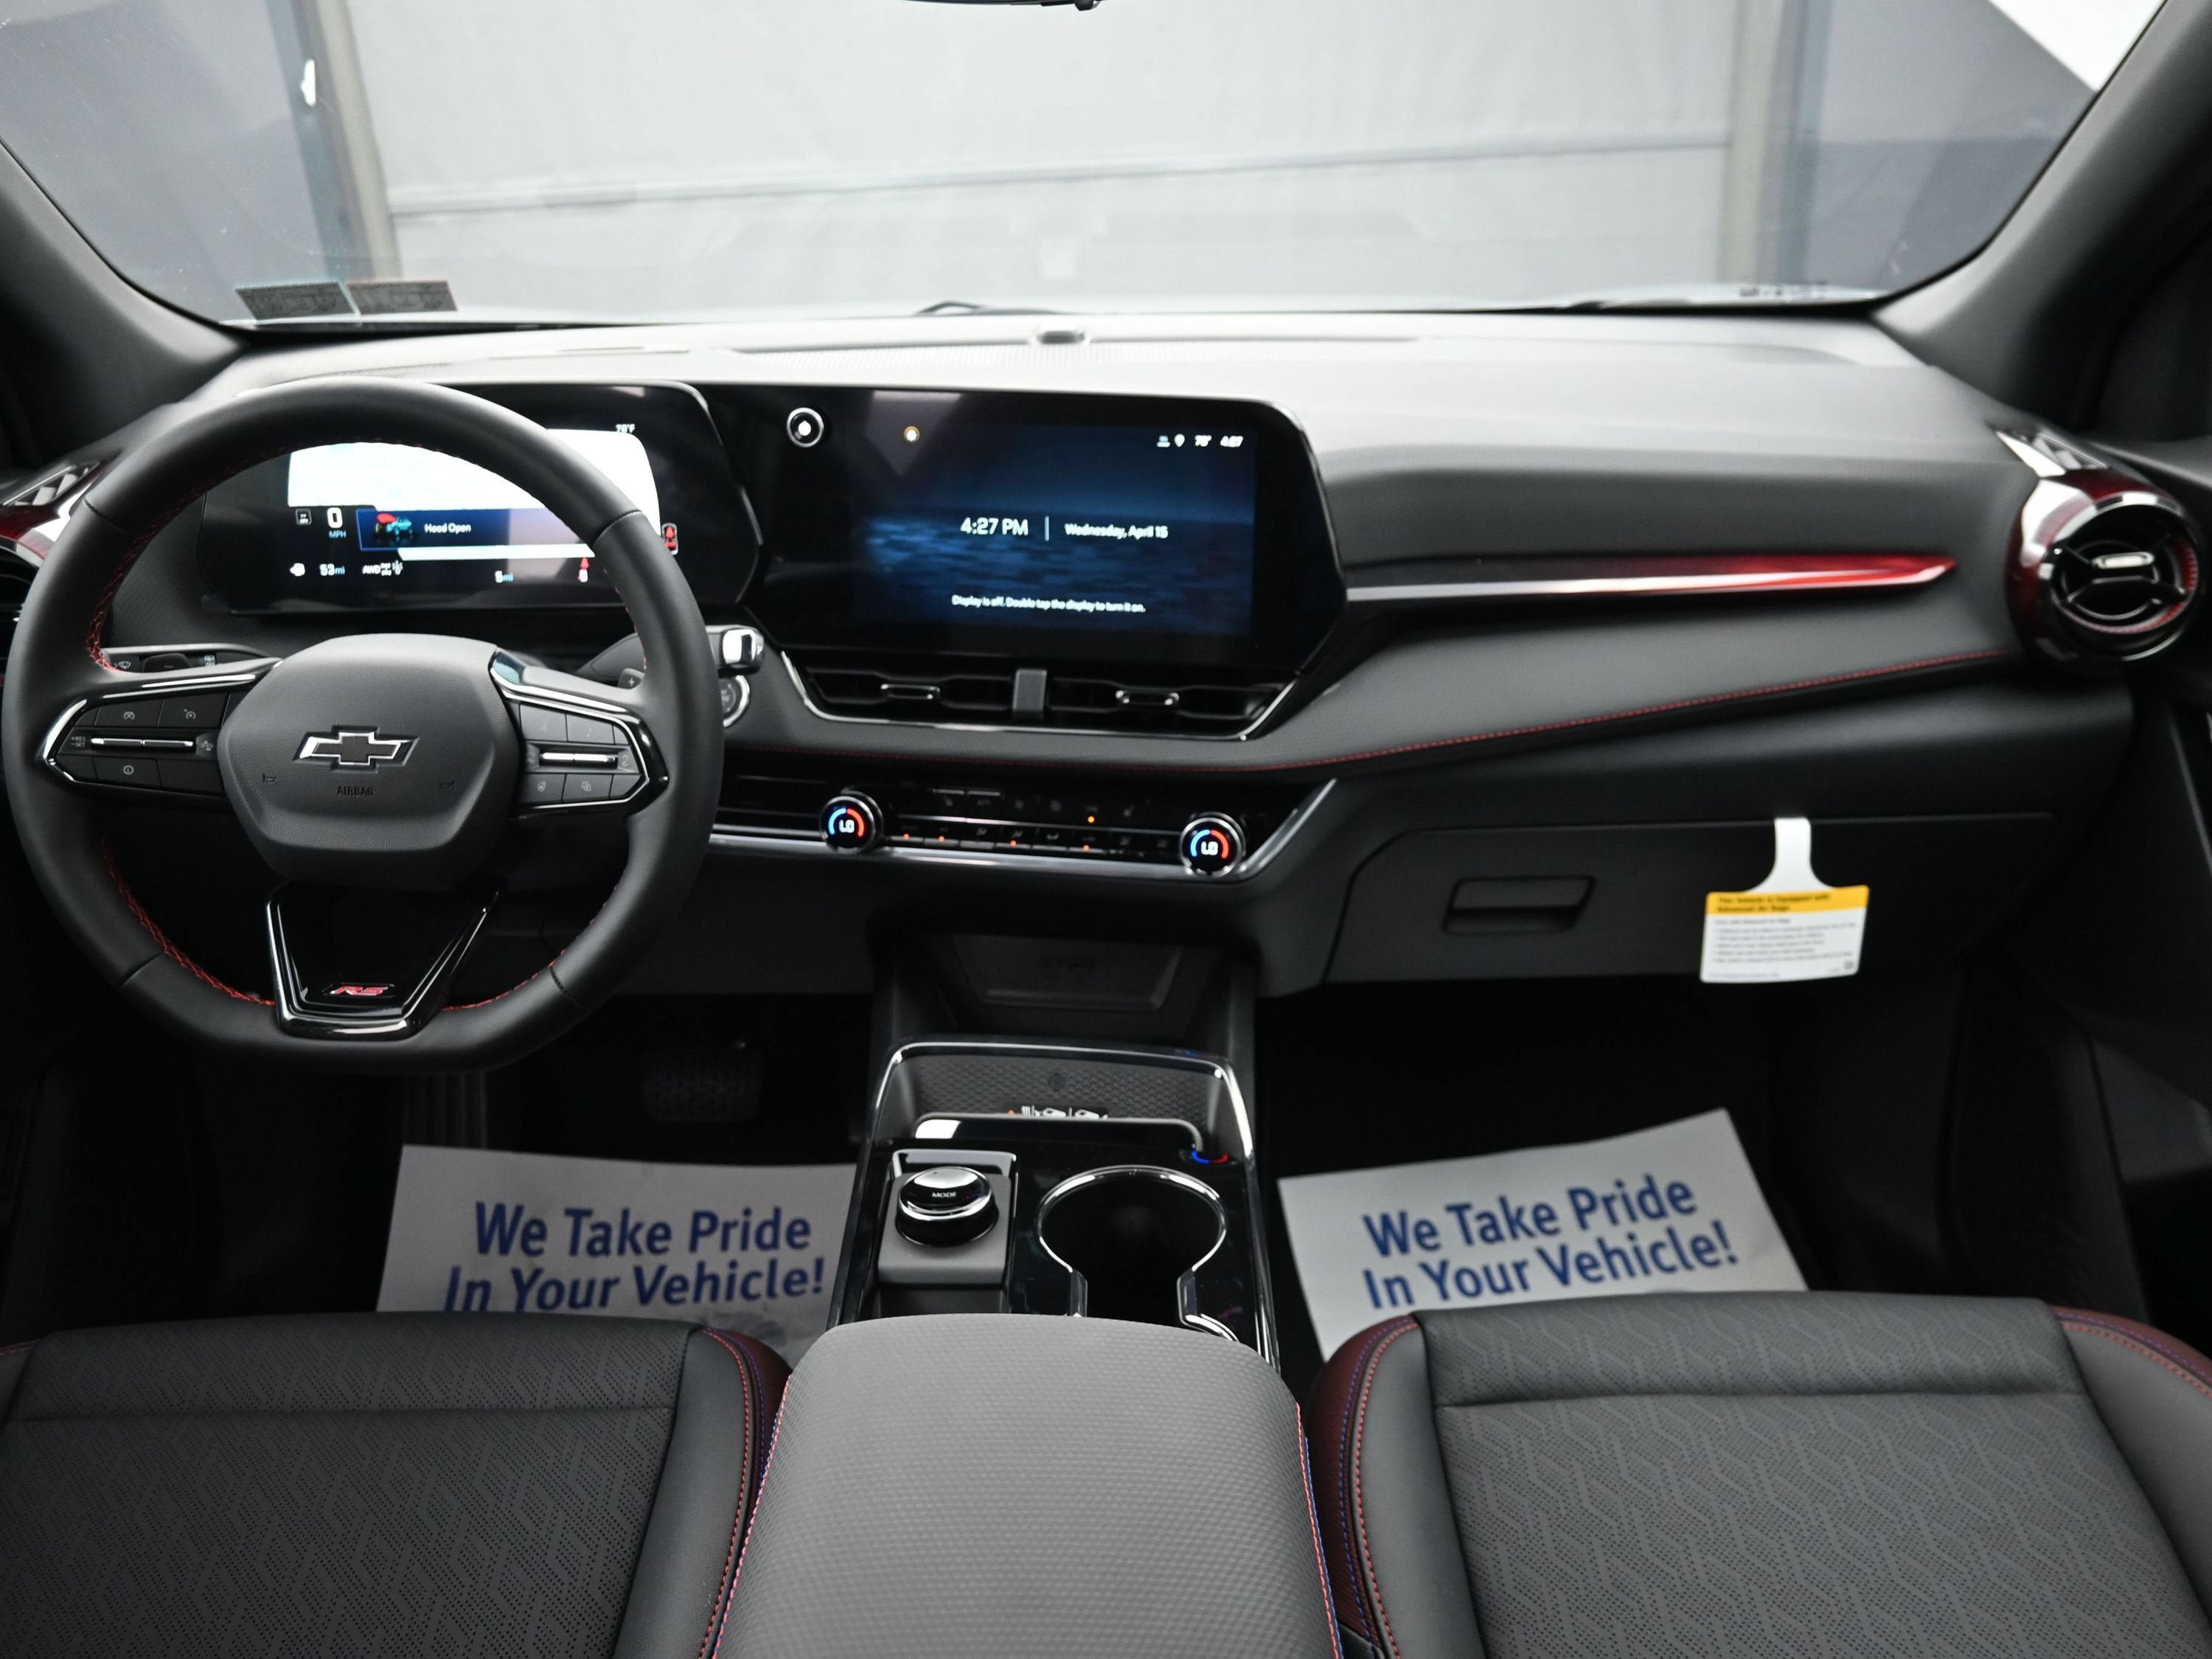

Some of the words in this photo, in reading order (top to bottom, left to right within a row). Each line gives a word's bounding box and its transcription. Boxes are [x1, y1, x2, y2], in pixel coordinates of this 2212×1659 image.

[326, 507, 344, 529] 0
[960, 517, 999, 535] 4:27
[1001, 518, 1029, 536] PM
[329, 530, 347, 539] MPH
[424, 522, 447, 534] Hood
[448, 523, 472, 535] Open
[1064, 523, 1127, 540] Wednesday,
[1128, 525, 1154, 540] April
[951, 594, 982, 608] Display
[1006, 597, 1035, 608] Double
[1036, 599, 1051, 611] tap
[1051, 599, 1065, 610] the
[1065, 599, 1095, 613] display
[336, 785, 374, 796] AIRBAG
[330, 985, 388, 996] RS
[1361, 1210, 1441, 1258] We
[1444, 1195, 1560, 1248] Take
[1567, 1173, 1697, 1231] Pride
[474, 1202, 547, 1256] We
[563, 1207, 672, 1257] Take
[687, 1206, 810, 1253] Pride
[1363, 1268, 1415, 1310] In
[1419, 1257, 1531, 1301] Your
[1534, 1220, 1739, 1288] Vehicle!
[445, 1265, 492, 1312] In
[510, 1265, 619, 1312] Your
[632, 1256, 825, 1306] Vehicle!
